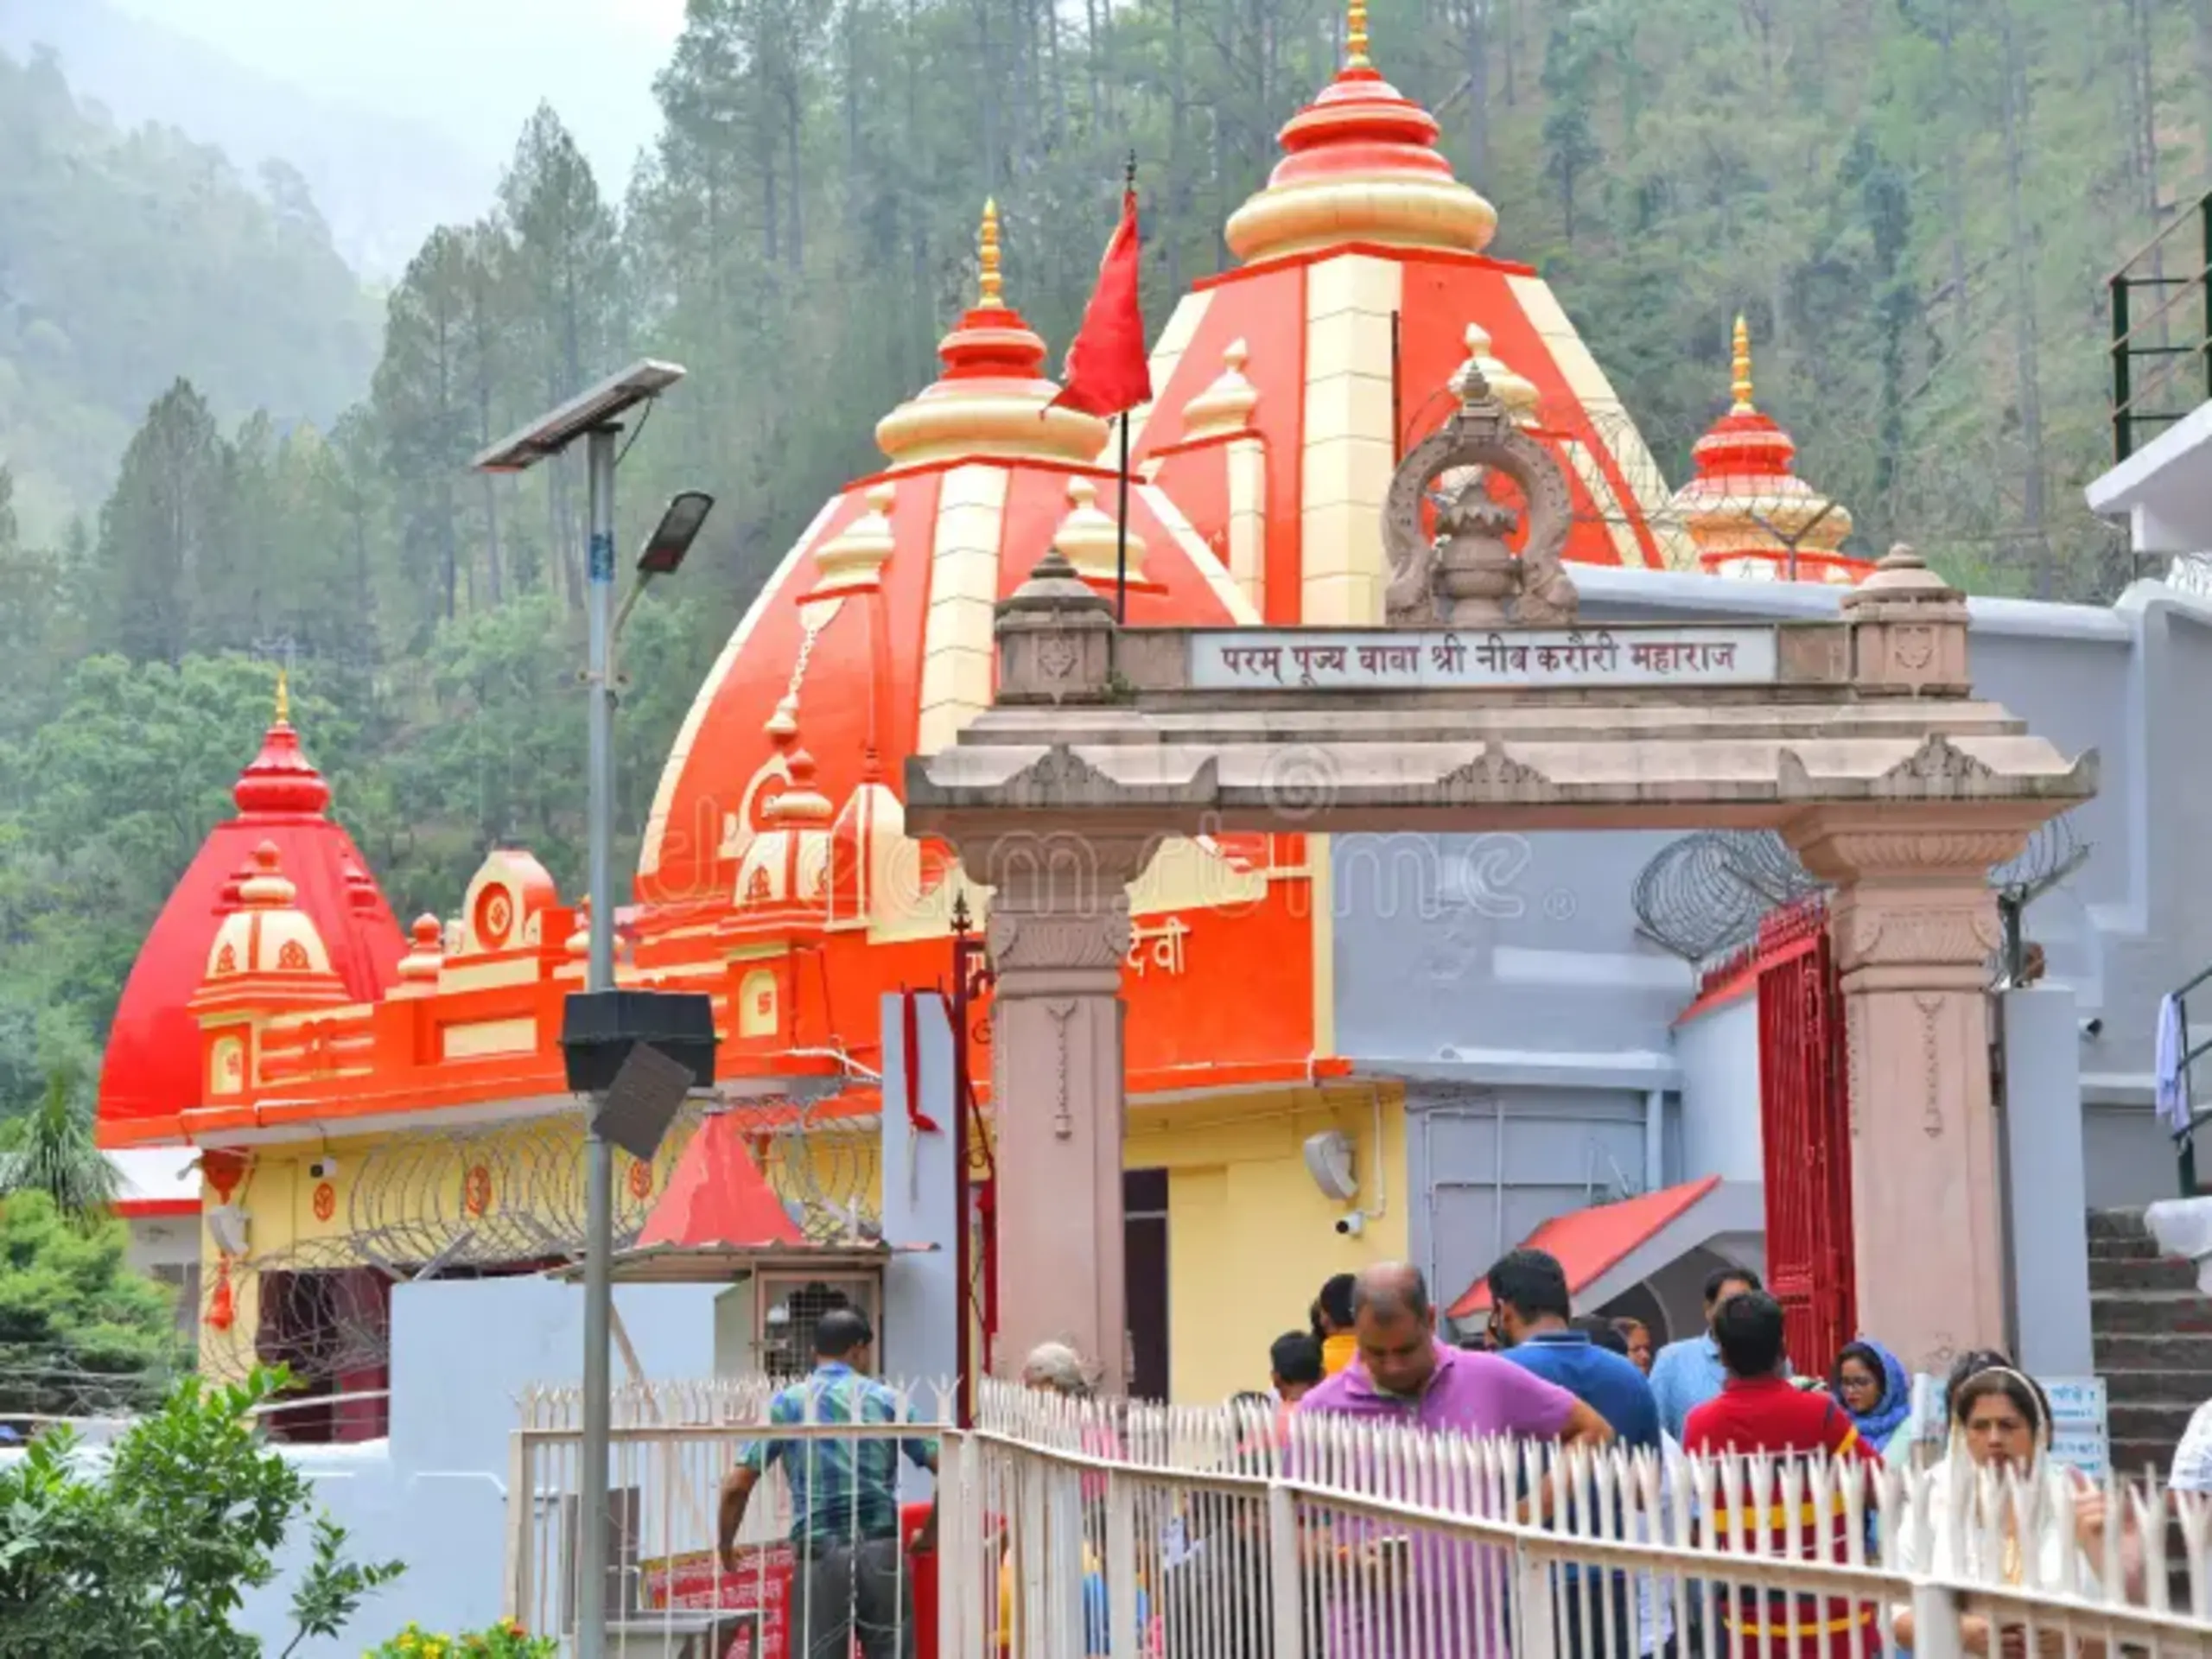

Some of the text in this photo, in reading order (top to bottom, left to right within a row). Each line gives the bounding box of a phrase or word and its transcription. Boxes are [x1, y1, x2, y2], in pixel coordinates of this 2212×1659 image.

[1221, 645, 1283, 683] परम्
[1291, 645, 1346, 686] पूज्य
[1431, 632, 1466, 673] श्री
[1629, 643, 1737, 674] महाराज
